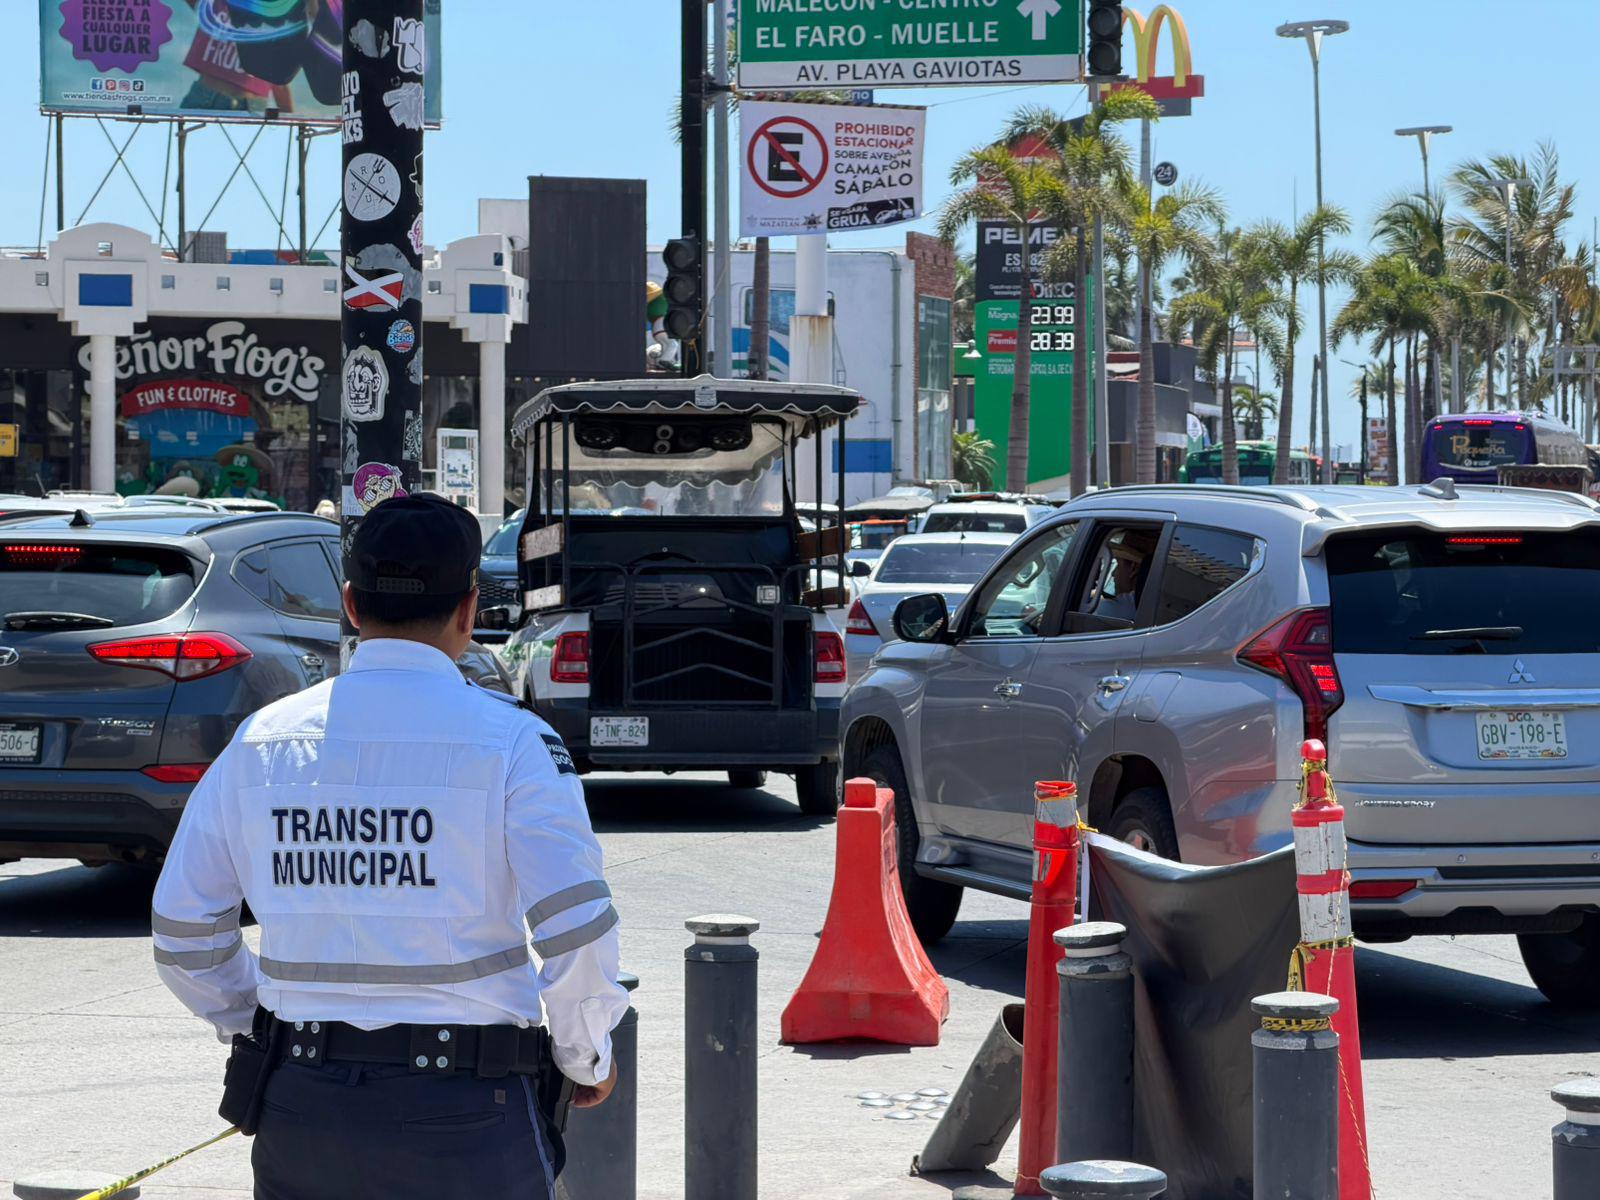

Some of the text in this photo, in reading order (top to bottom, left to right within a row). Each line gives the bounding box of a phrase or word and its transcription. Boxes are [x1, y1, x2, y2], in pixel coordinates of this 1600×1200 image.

[83, 6, 151, 22] FIESTA A
[83, 21, 151, 35] CUALQUIER
[756, 26, 786, 48] EL
[795, 24, 866, 47] FARO
[892, 21, 999, 45] MUELLE
[83, 35, 151, 54] LUGAR
[796, 59, 1022, 82] AV. PLAYA GAVIOTAS
[63, 92, 171, 103] www.tiendasfrogs.com.mx
[835, 122, 915, 138] PROHIBIDO
[835, 150, 868, 160] SOBRE
[1156, 166, 1172, 178] 24
[834, 172, 913, 196] SÁBALO
[829, 214, 872, 229] GRUA
[1030, 306, 1075, 325] 23.99
[1030, 332, 1075, 351] 28.39
[136, 387, 165, 407] FUN
[177, 386, 238, 407] CLOTHES
[1481, 722, 1564, 745] GBV-198-E
[271, 807, 434, 844] TRANSITO
[272, 851, 437, 888] MUNICIPAL
